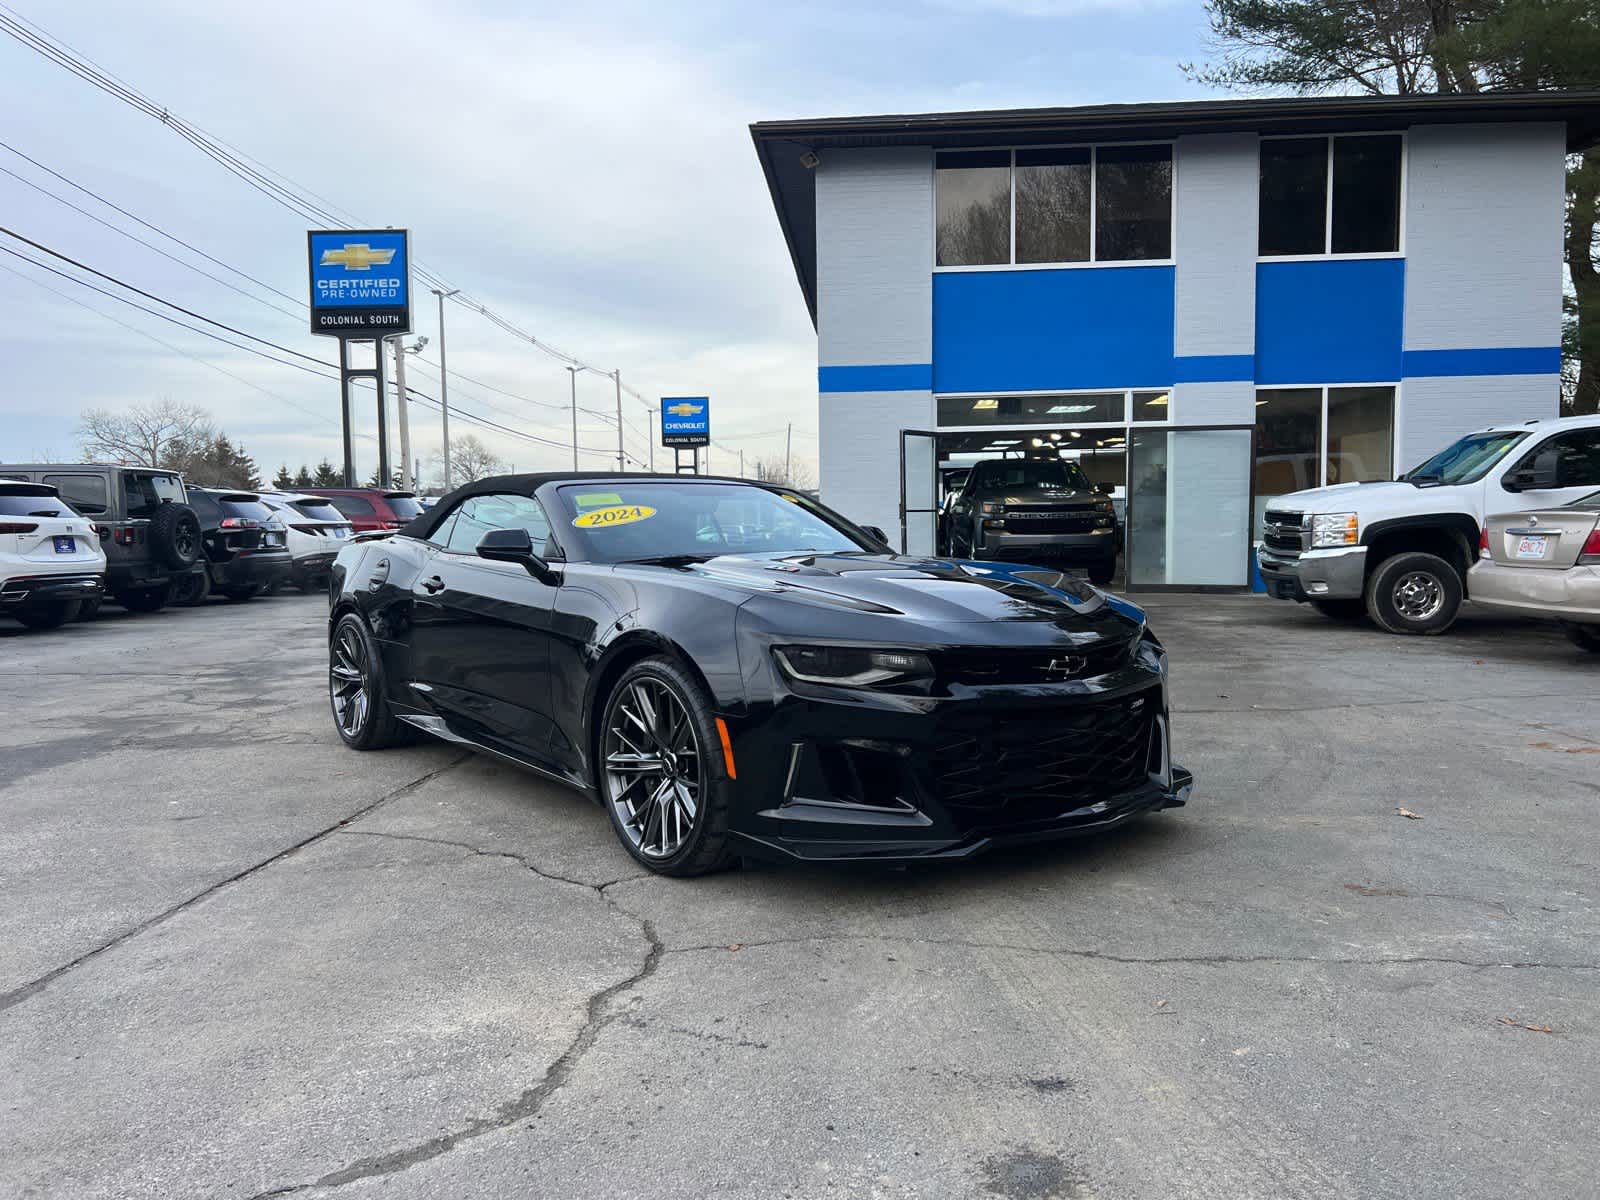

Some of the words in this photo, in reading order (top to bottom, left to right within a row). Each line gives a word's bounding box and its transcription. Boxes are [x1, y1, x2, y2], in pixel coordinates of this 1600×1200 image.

[317, 279, 400, 289] CERTIFIED
[321, 288, 396, 298] PRE-OWNED
[320, 316, 365, 325] COLONIAL
[370, 315, 399, 324] SOUTH
[590, 507, 642, 525] 2024
